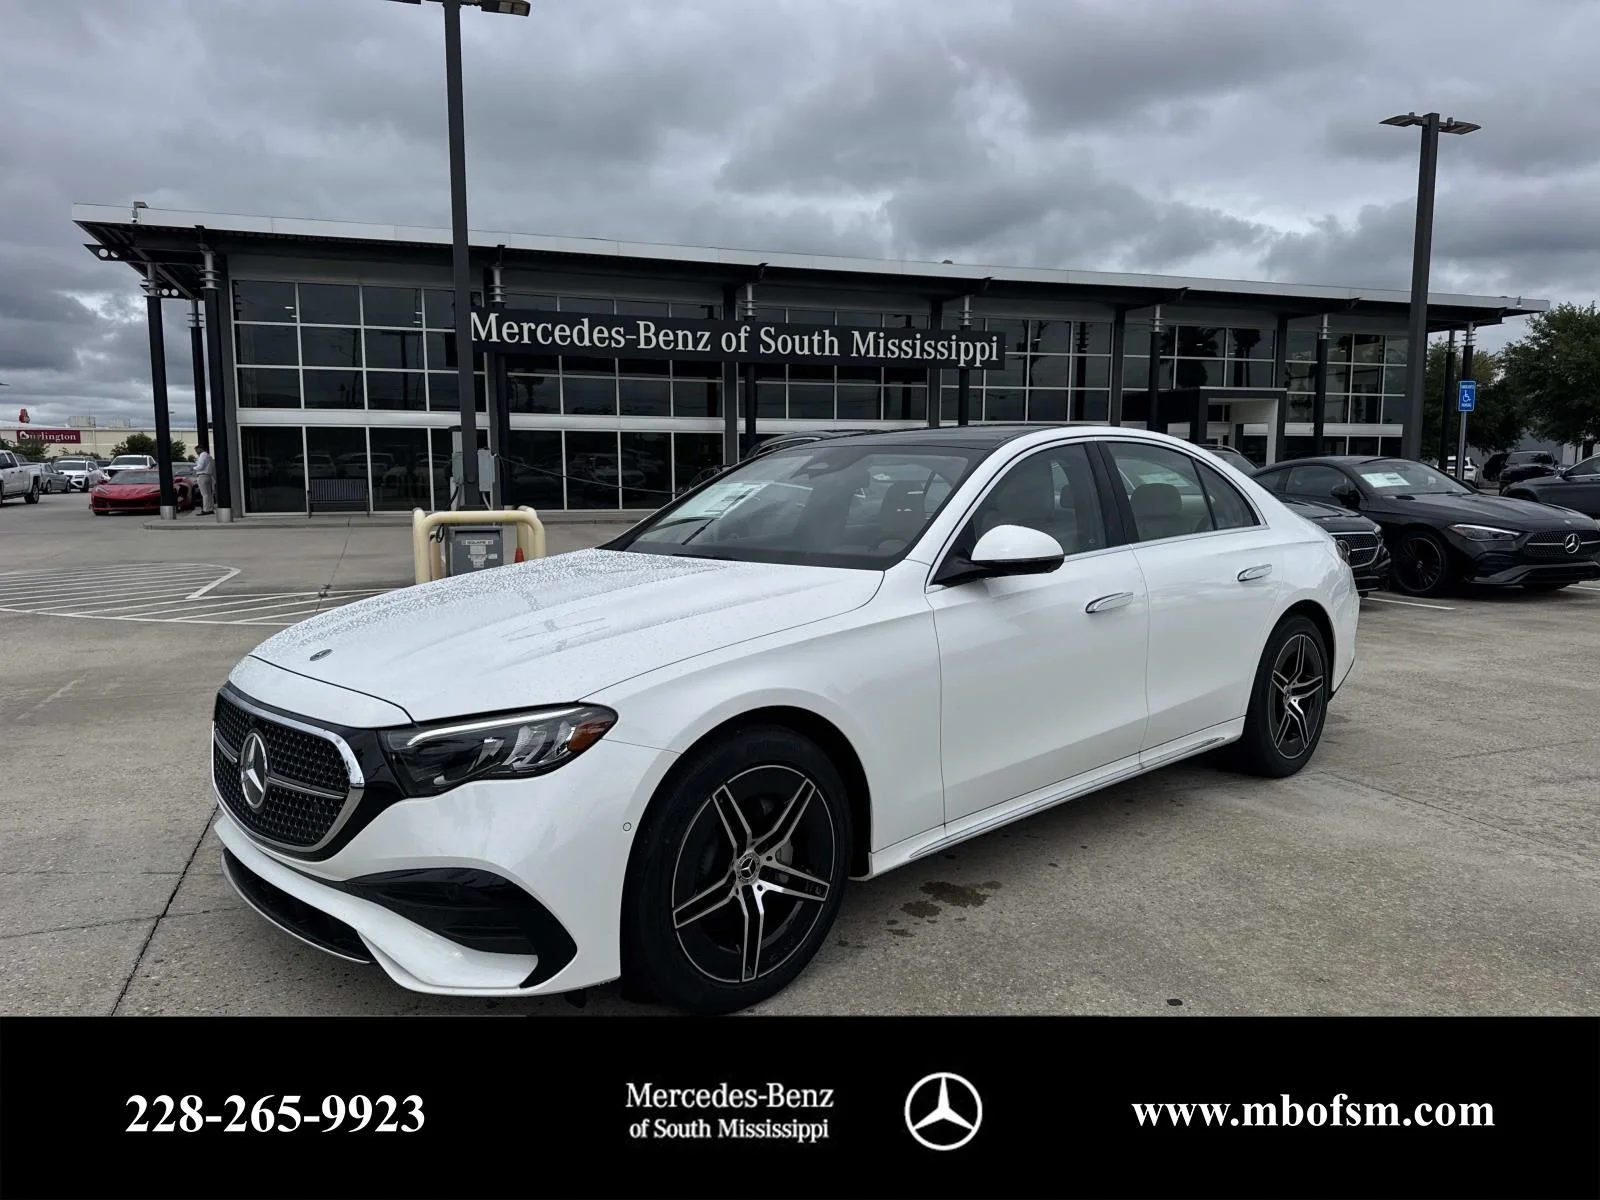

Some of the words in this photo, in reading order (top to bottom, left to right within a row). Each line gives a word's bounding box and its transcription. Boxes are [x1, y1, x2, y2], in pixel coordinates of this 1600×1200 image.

[470, 312, 711, 351] Mercedes-Benz
[721, 325, 750, 353] of
[759, 327, 840, 356] South
[850, 331, 998, 367] Mississippi
